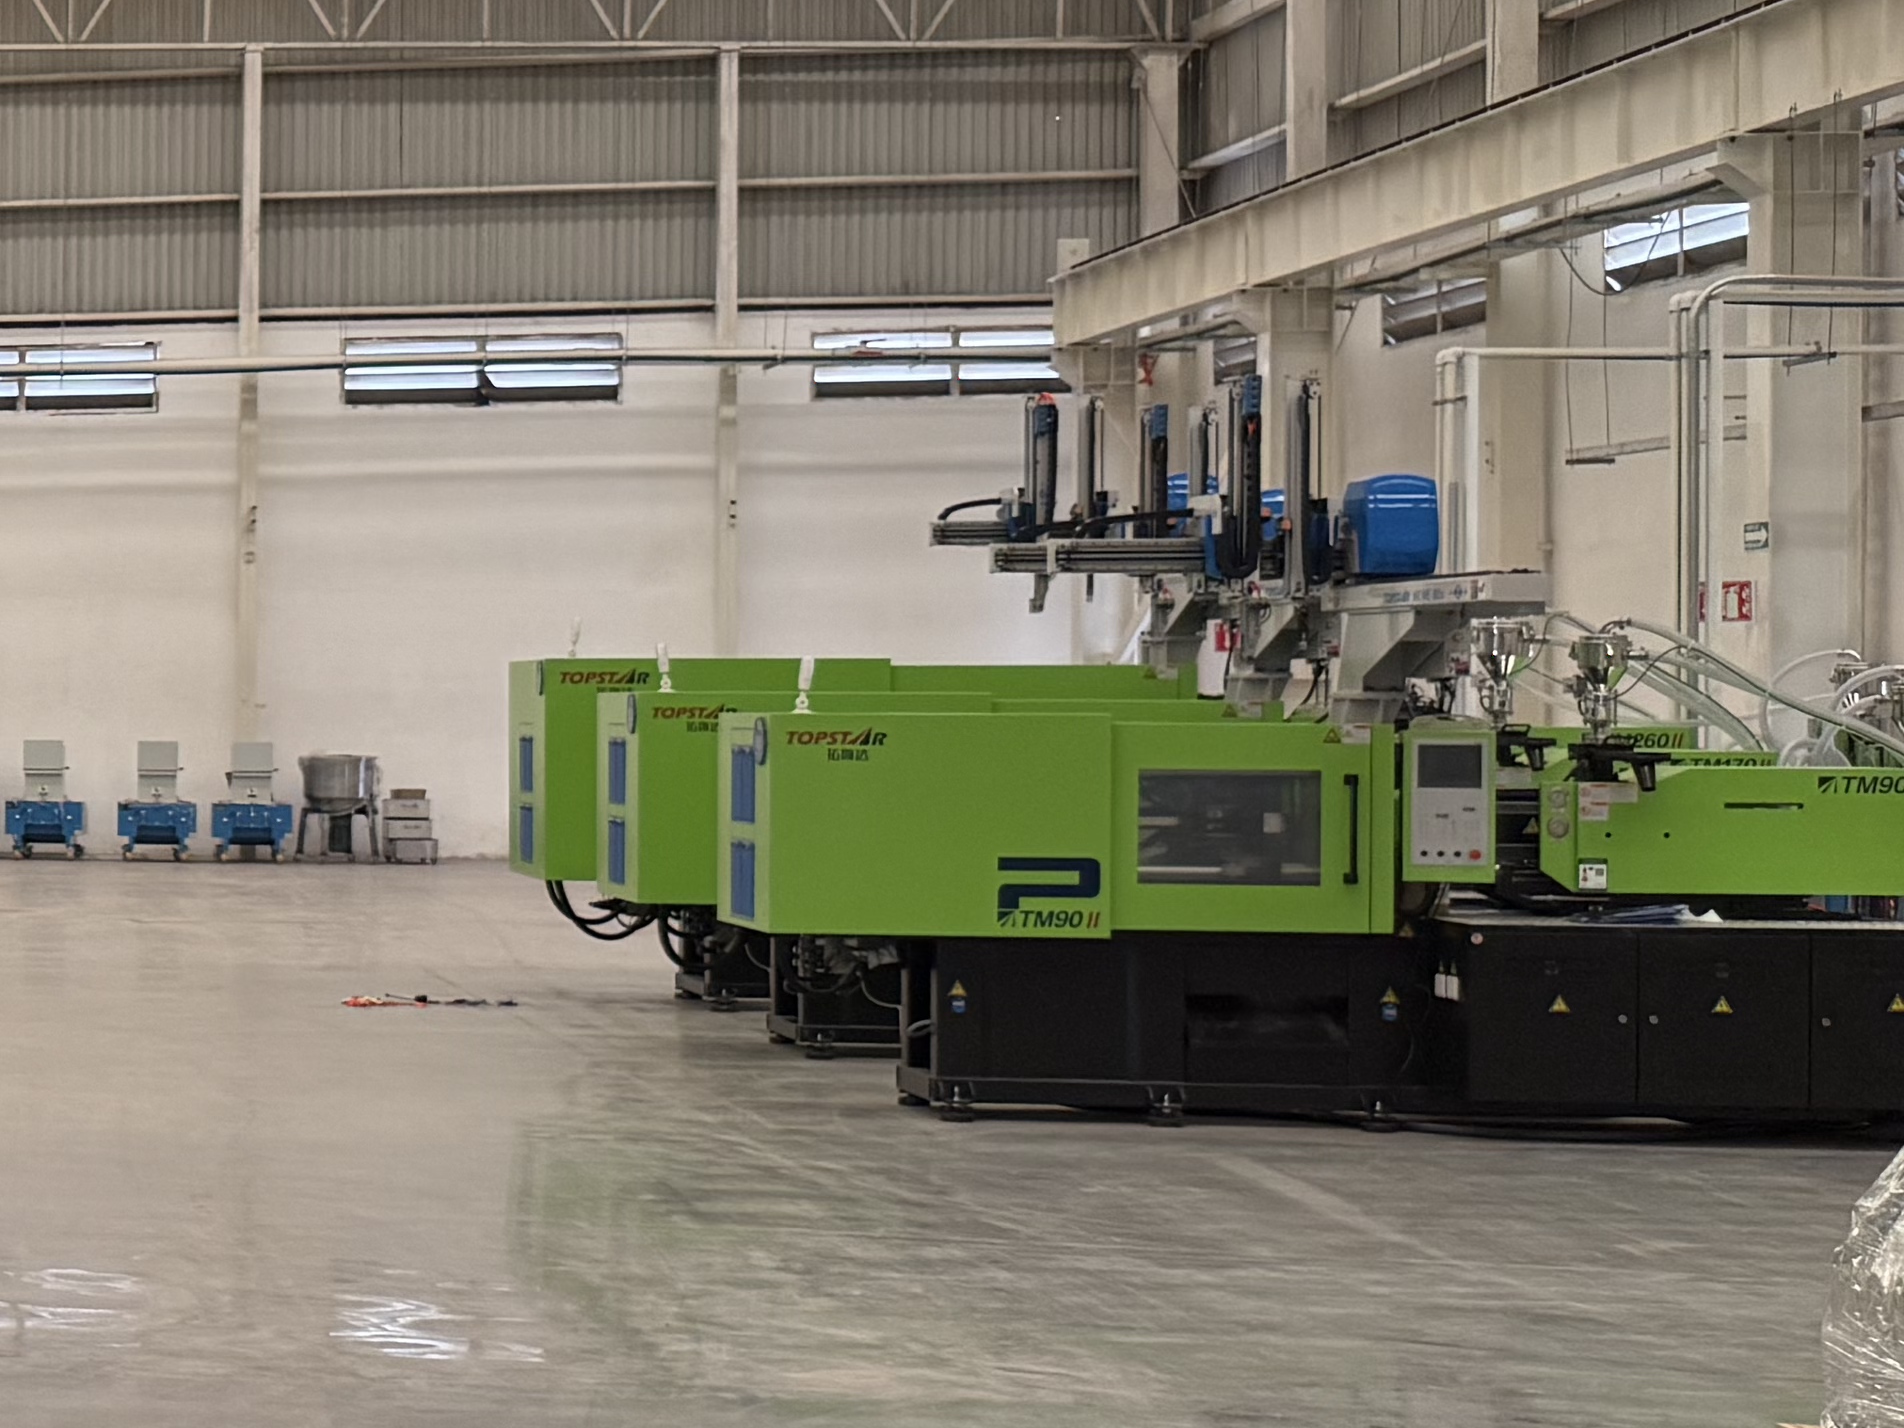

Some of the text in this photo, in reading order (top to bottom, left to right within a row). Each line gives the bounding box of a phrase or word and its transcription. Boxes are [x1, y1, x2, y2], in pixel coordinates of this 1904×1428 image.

[560, 668, 650, 685] TOPSTAR
[786, 727, 888, 746] TOPSTAR
[1019, 910, 1084, 928] TM90
